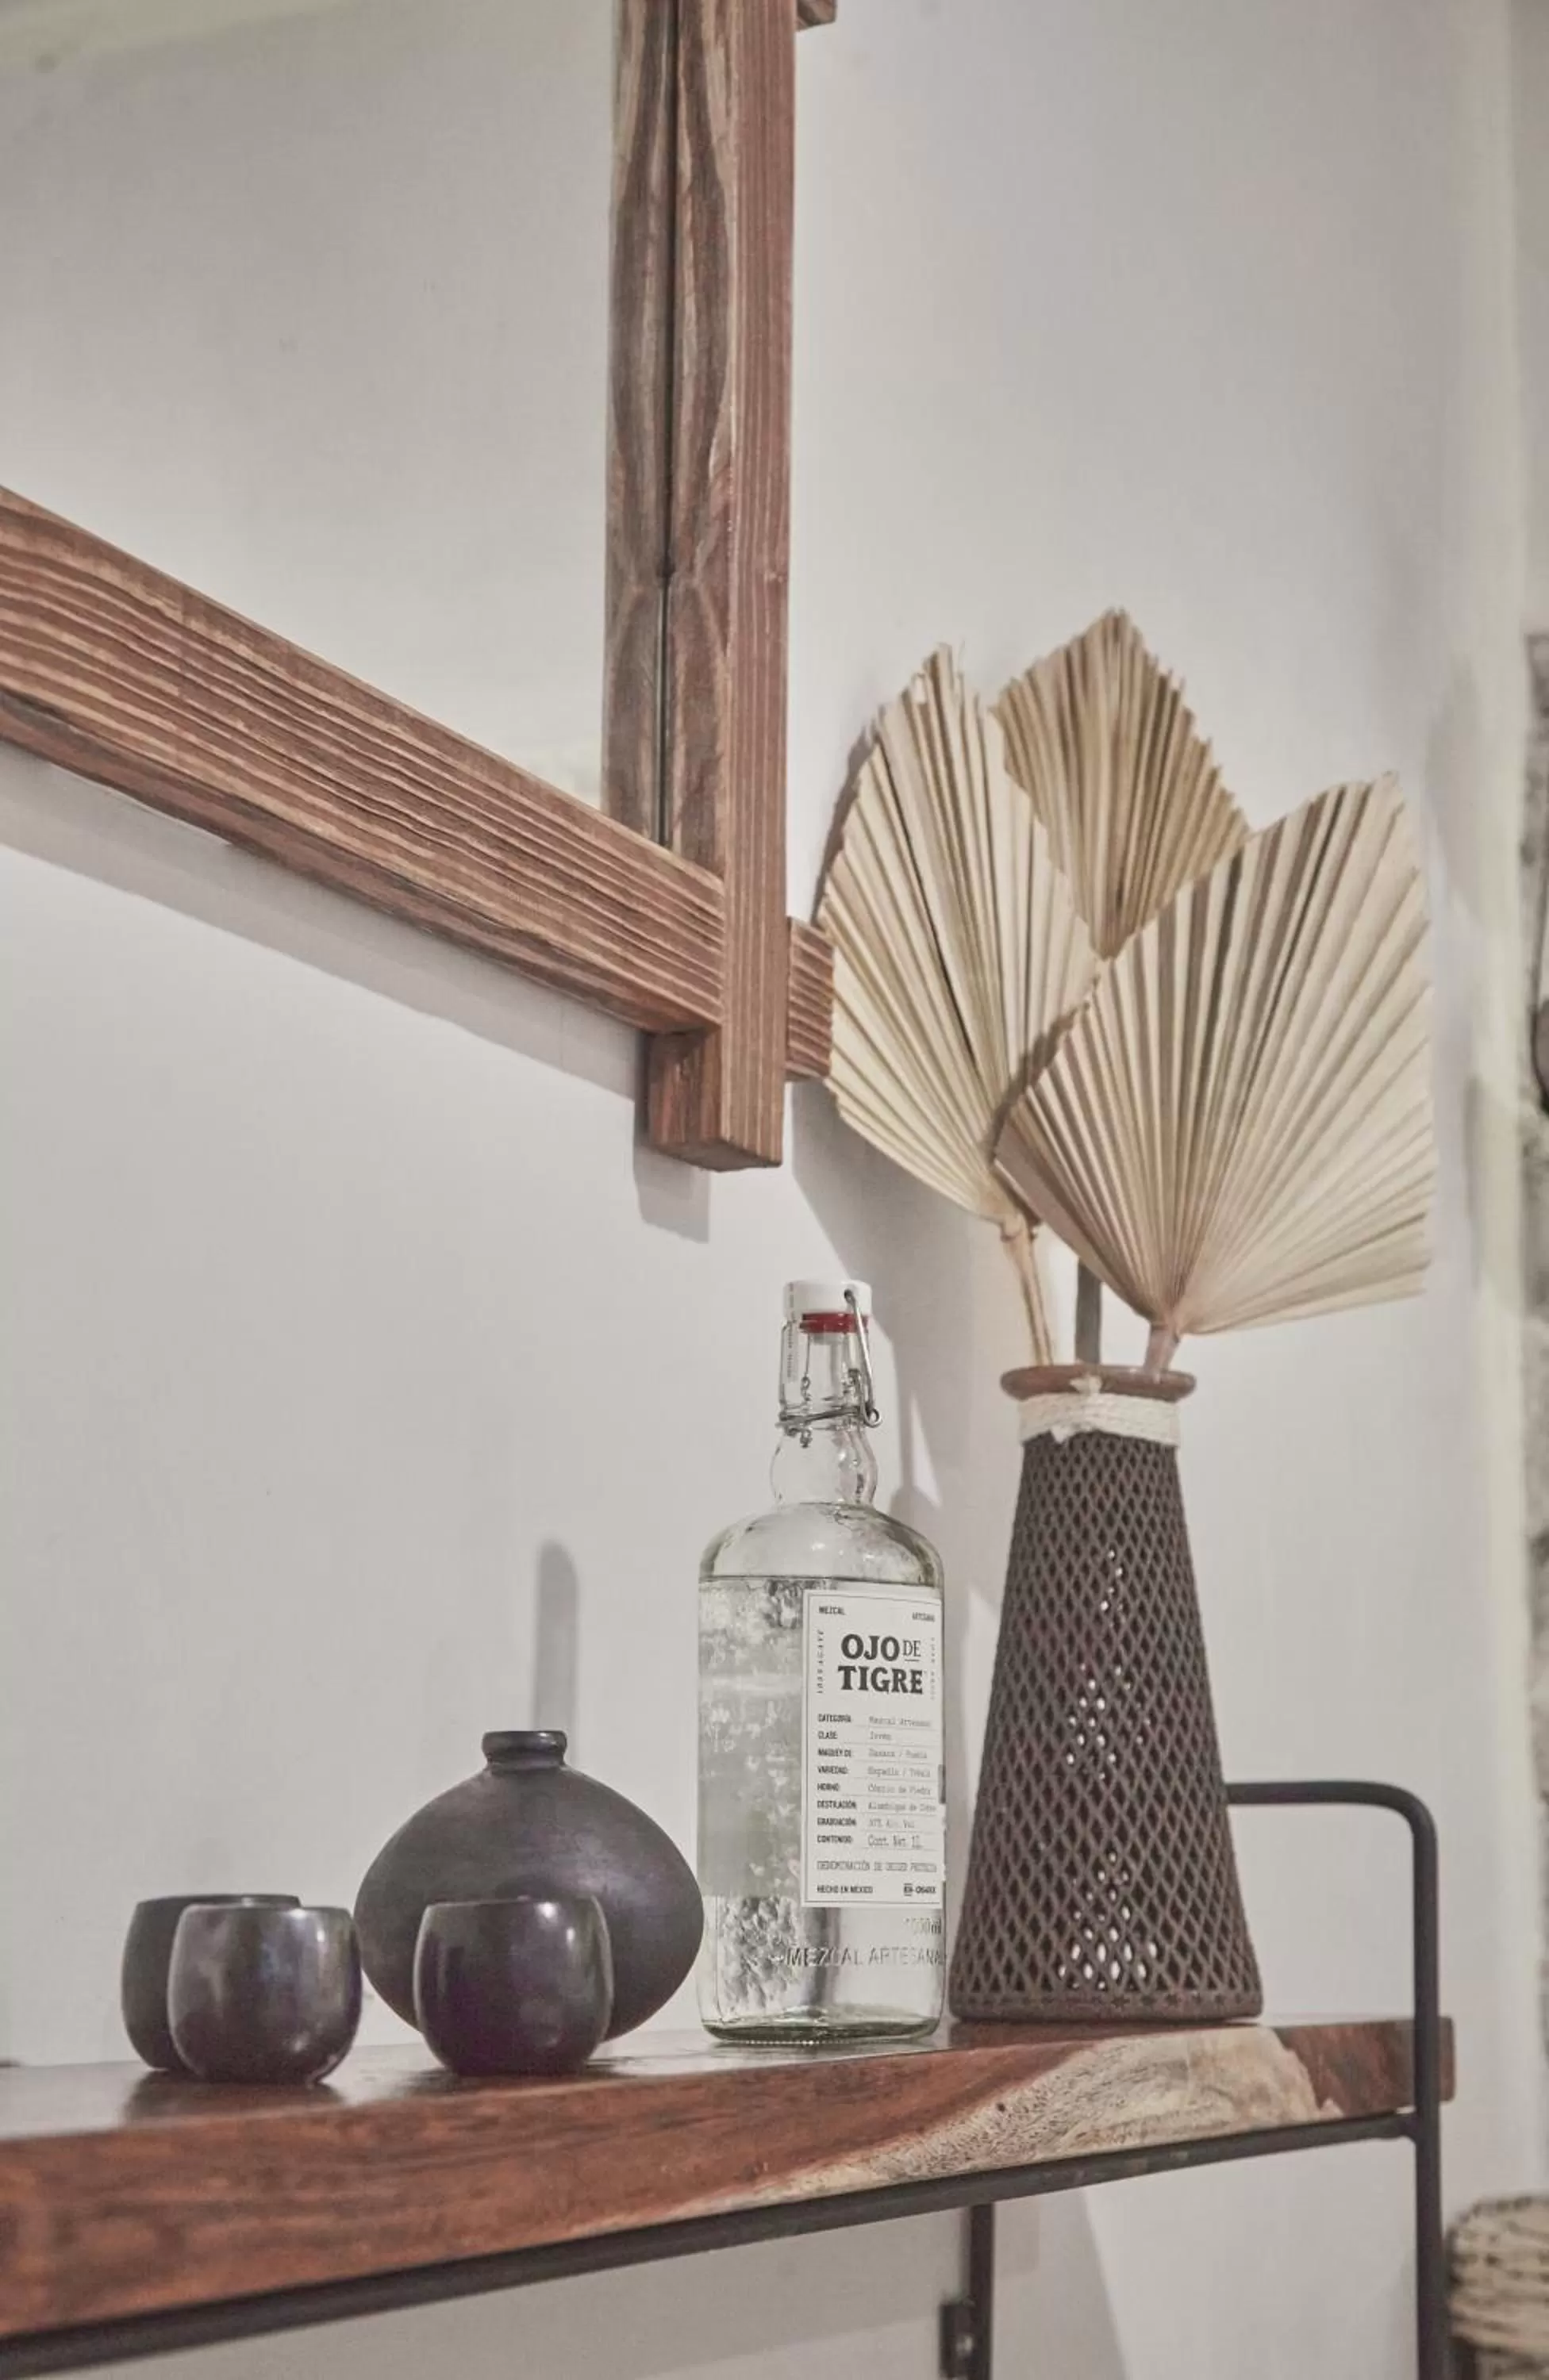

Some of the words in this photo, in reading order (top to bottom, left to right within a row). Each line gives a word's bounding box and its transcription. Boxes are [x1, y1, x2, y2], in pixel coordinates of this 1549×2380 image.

[818, 1606, 846, 1615] MEZCAL
[840, 1633, 901, 1662] OJO
[902, 1639, 921, 1657] DE
[837, 1665, 924, 1695] TIGRE
[786, 1946, 864, 1968] MEZCAL
